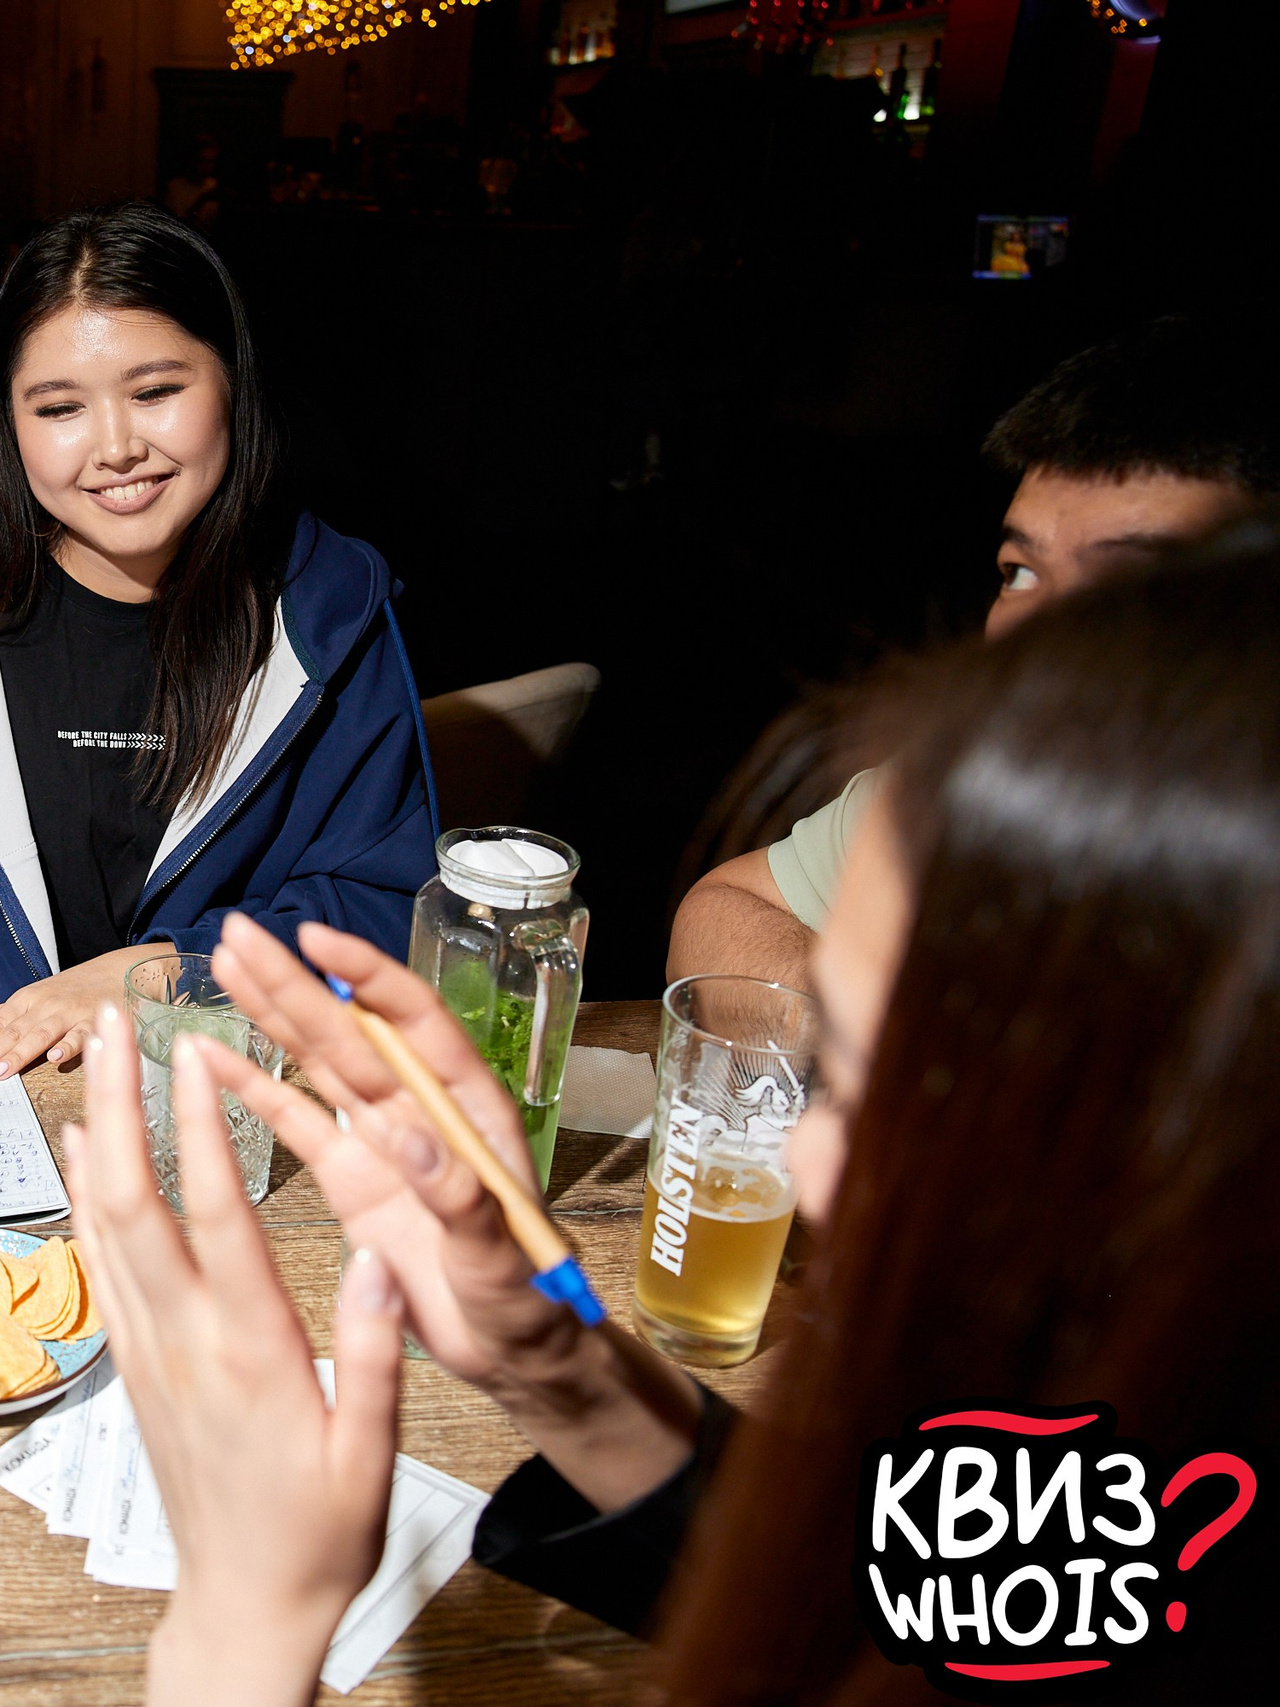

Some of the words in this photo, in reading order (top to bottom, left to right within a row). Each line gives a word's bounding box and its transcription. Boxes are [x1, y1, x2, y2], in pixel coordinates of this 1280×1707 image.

[57, 730, 79, 740] BEFORE
[81, 731, 92, 739] THE
[93, 731, 108, 740] CITY
[109, 732, 127, 741] FALLS
[72, 739, 96, 748] BEFORE
[97, 740, 108, 748] THE
[651, 1090, 704, 1277] HOLSTEN
